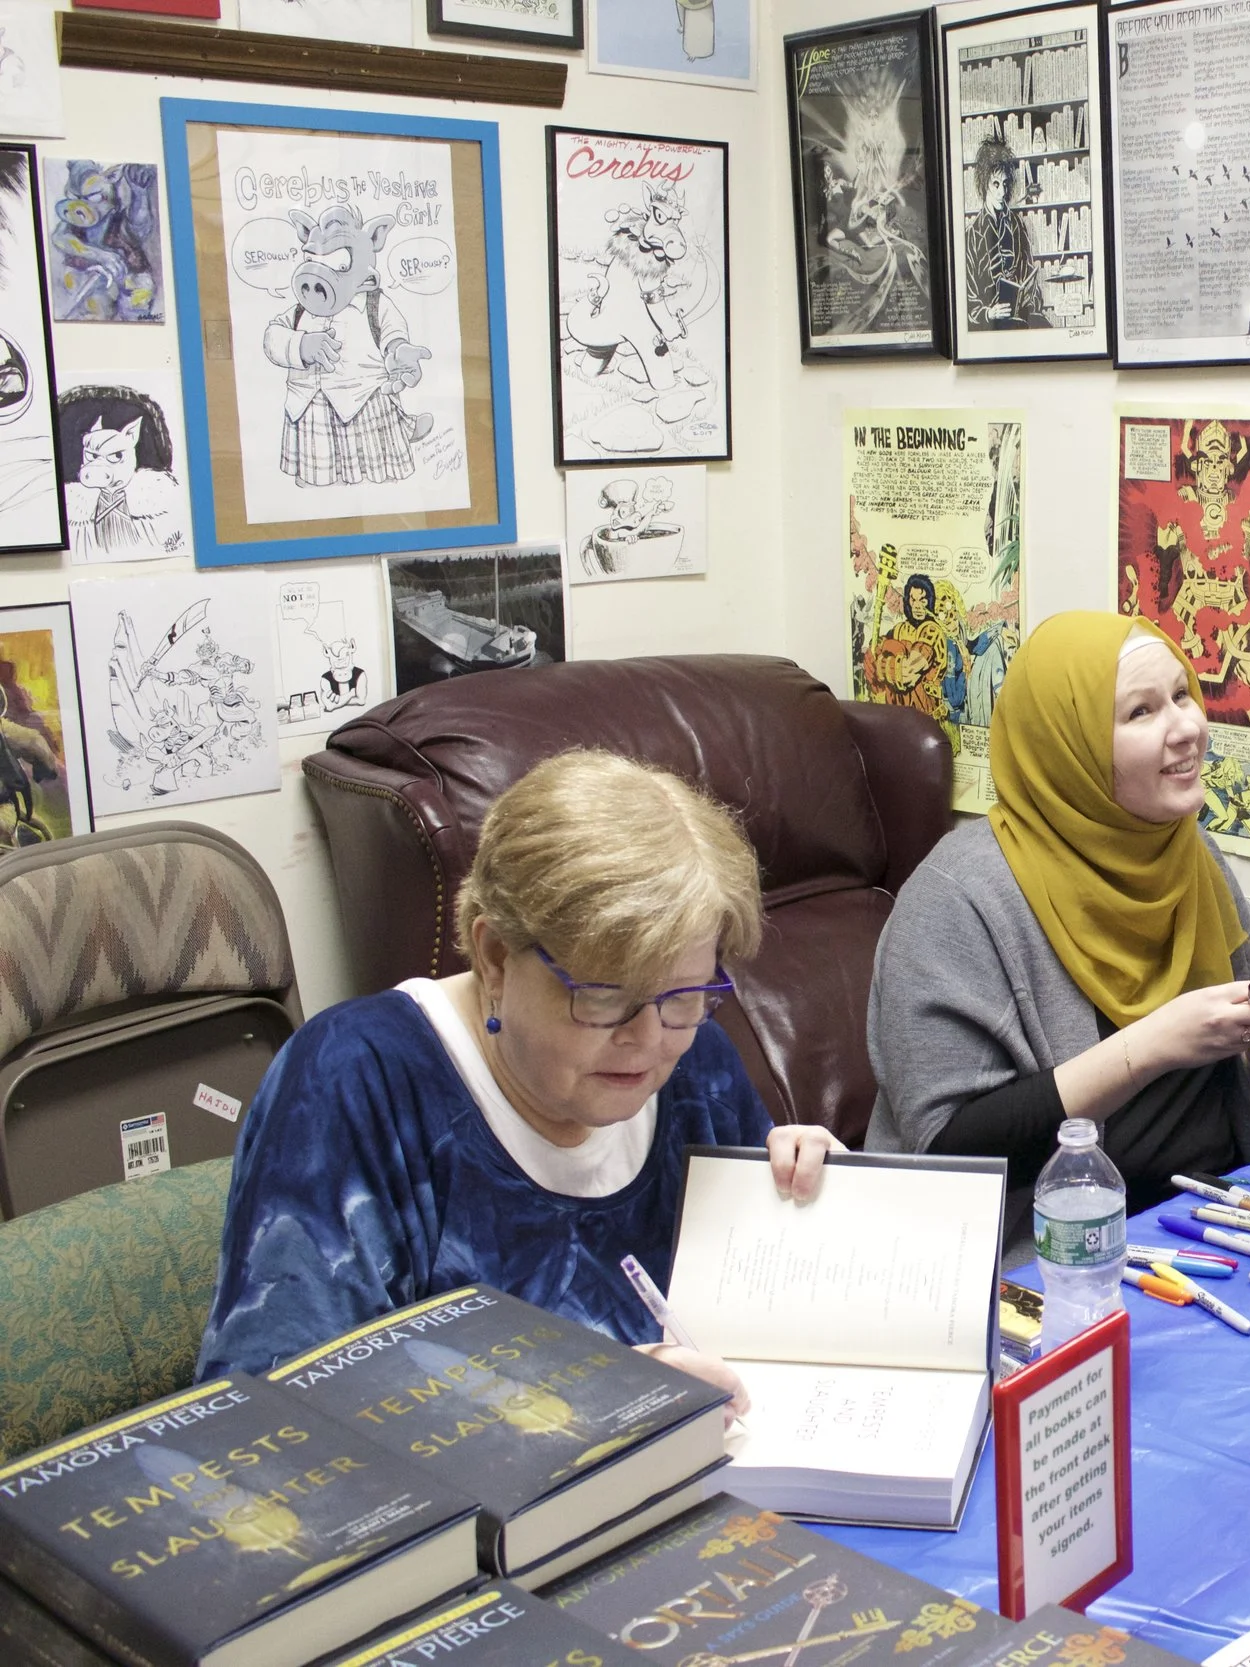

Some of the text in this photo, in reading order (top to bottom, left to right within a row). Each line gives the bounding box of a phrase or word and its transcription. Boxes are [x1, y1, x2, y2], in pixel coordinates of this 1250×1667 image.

[1118, 17, 1152, 39] BEFORE
[1154, 13, 1173, 32] YOU
[1177, 8, 1201, 28] READ
[1203, 6, 1223, 23] THIS
[566, 146, 694, 181] Cerebus
[572, 136, 589, 144] THE
[234, 166, 350, 211] Cerebus
[368, 171, 438, 201] Yeshiva
[396, 202, 442, 227] Girl!
[854, 426, 866, 448] IN
[871, 427, 891, 449] THE
[285, 1293, 499, 1390] TAMORA PIERCE
[355, 1325, 563, 1425] TEMPESTS
[409, 1350, 624, 1459] SLAUGHTER
[1028, 1366, 1104, 1426] Payment for
[0, 1388, 251, 1499] TAMORA PIERCE
[1025, 1388, 1108, 1452] all books can
[1033, 1414, 1103, 1471] be made at
[59, 1425, 310, 1541] TEMPESTS
[1025, 1432, 1111, 1502] the front desk
[1031, 1460, 1108, 1523] after getting
[109, 1456, 368, 1580] SLAUGHTER
[1038, 1487, 1103, 1546] your items
[1051, 1518, 1094, 1558] signed.
[555, 1512, 729, 1610] AMORA PIERCE
[608, 1546, 818, 1650] ORTALL
[716, 1619, 756, 1644] SPY'S
[754, 1592, 800, 1622] GUIDE
[416, 1602, 526, 1661] PIERCE
[996, 1630, 1064, 1667] ERCE
